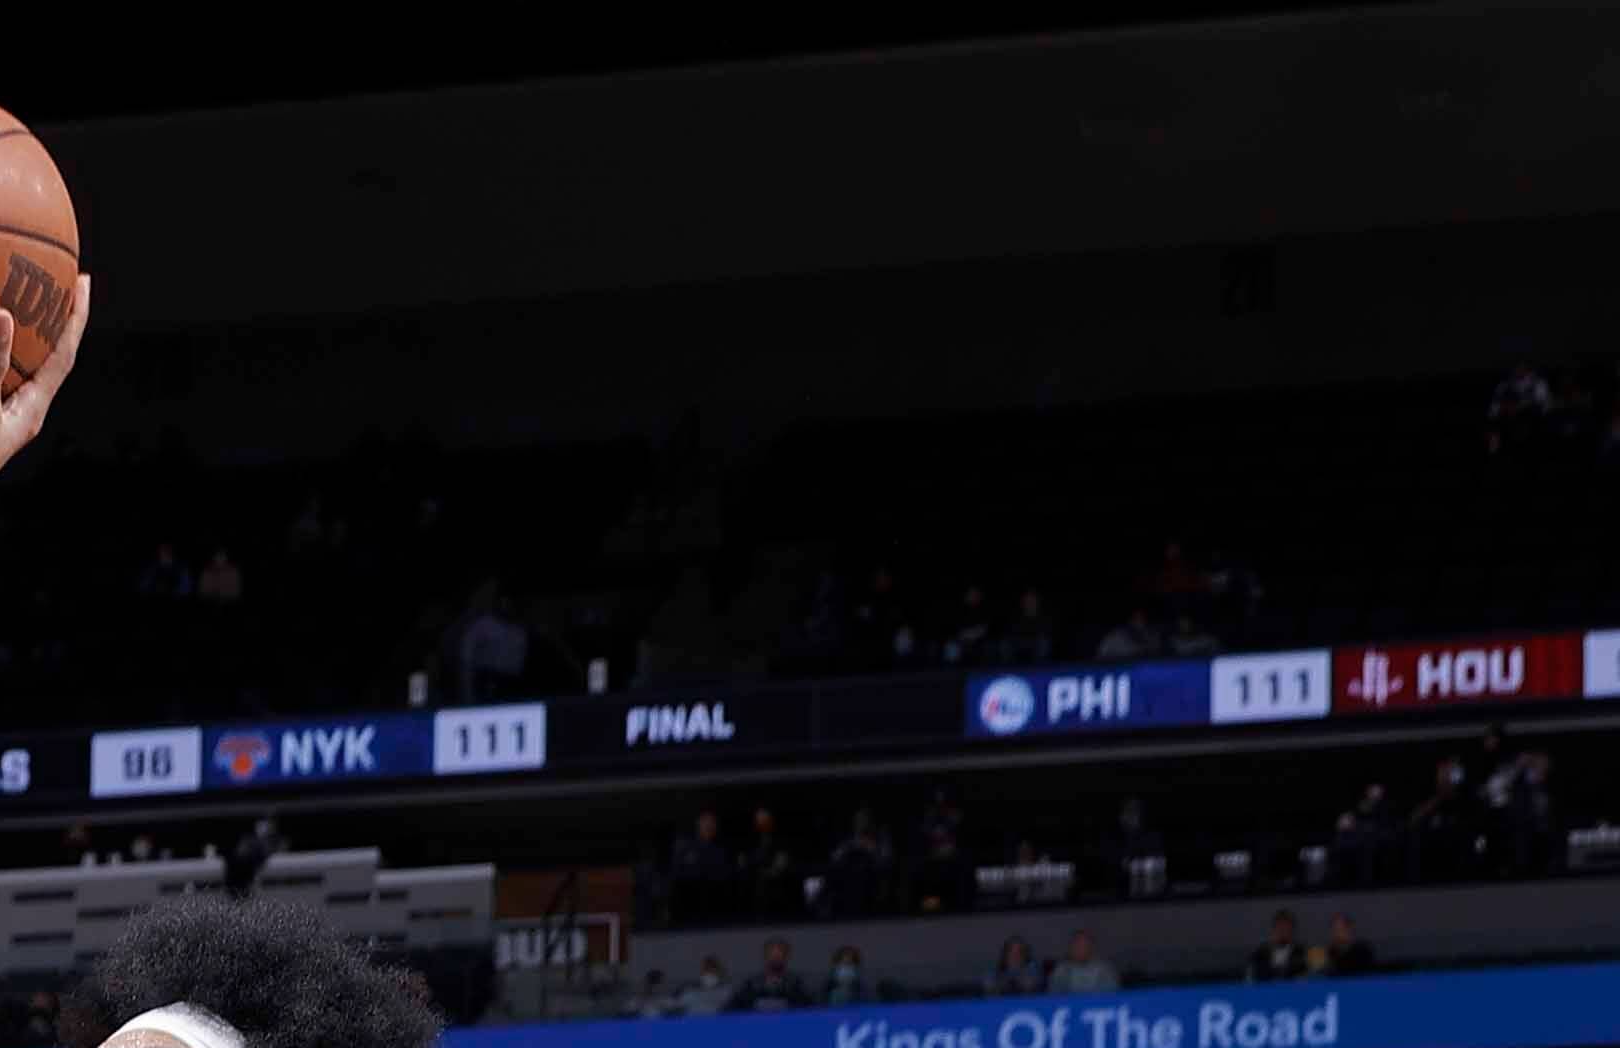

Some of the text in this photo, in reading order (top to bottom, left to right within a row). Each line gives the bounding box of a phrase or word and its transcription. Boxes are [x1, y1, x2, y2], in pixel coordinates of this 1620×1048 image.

[1231, 667, 1313, 705] 111
[1417, 648, 1525, 696] HOU
[1047, 676, 1131, 722] PHI
[455, 720, 529, 760] 111
[626, 703, 735, 745] FINAL
[281, 726, 375, 774] NYK
[1196, 995, 1339, 1048] Road
